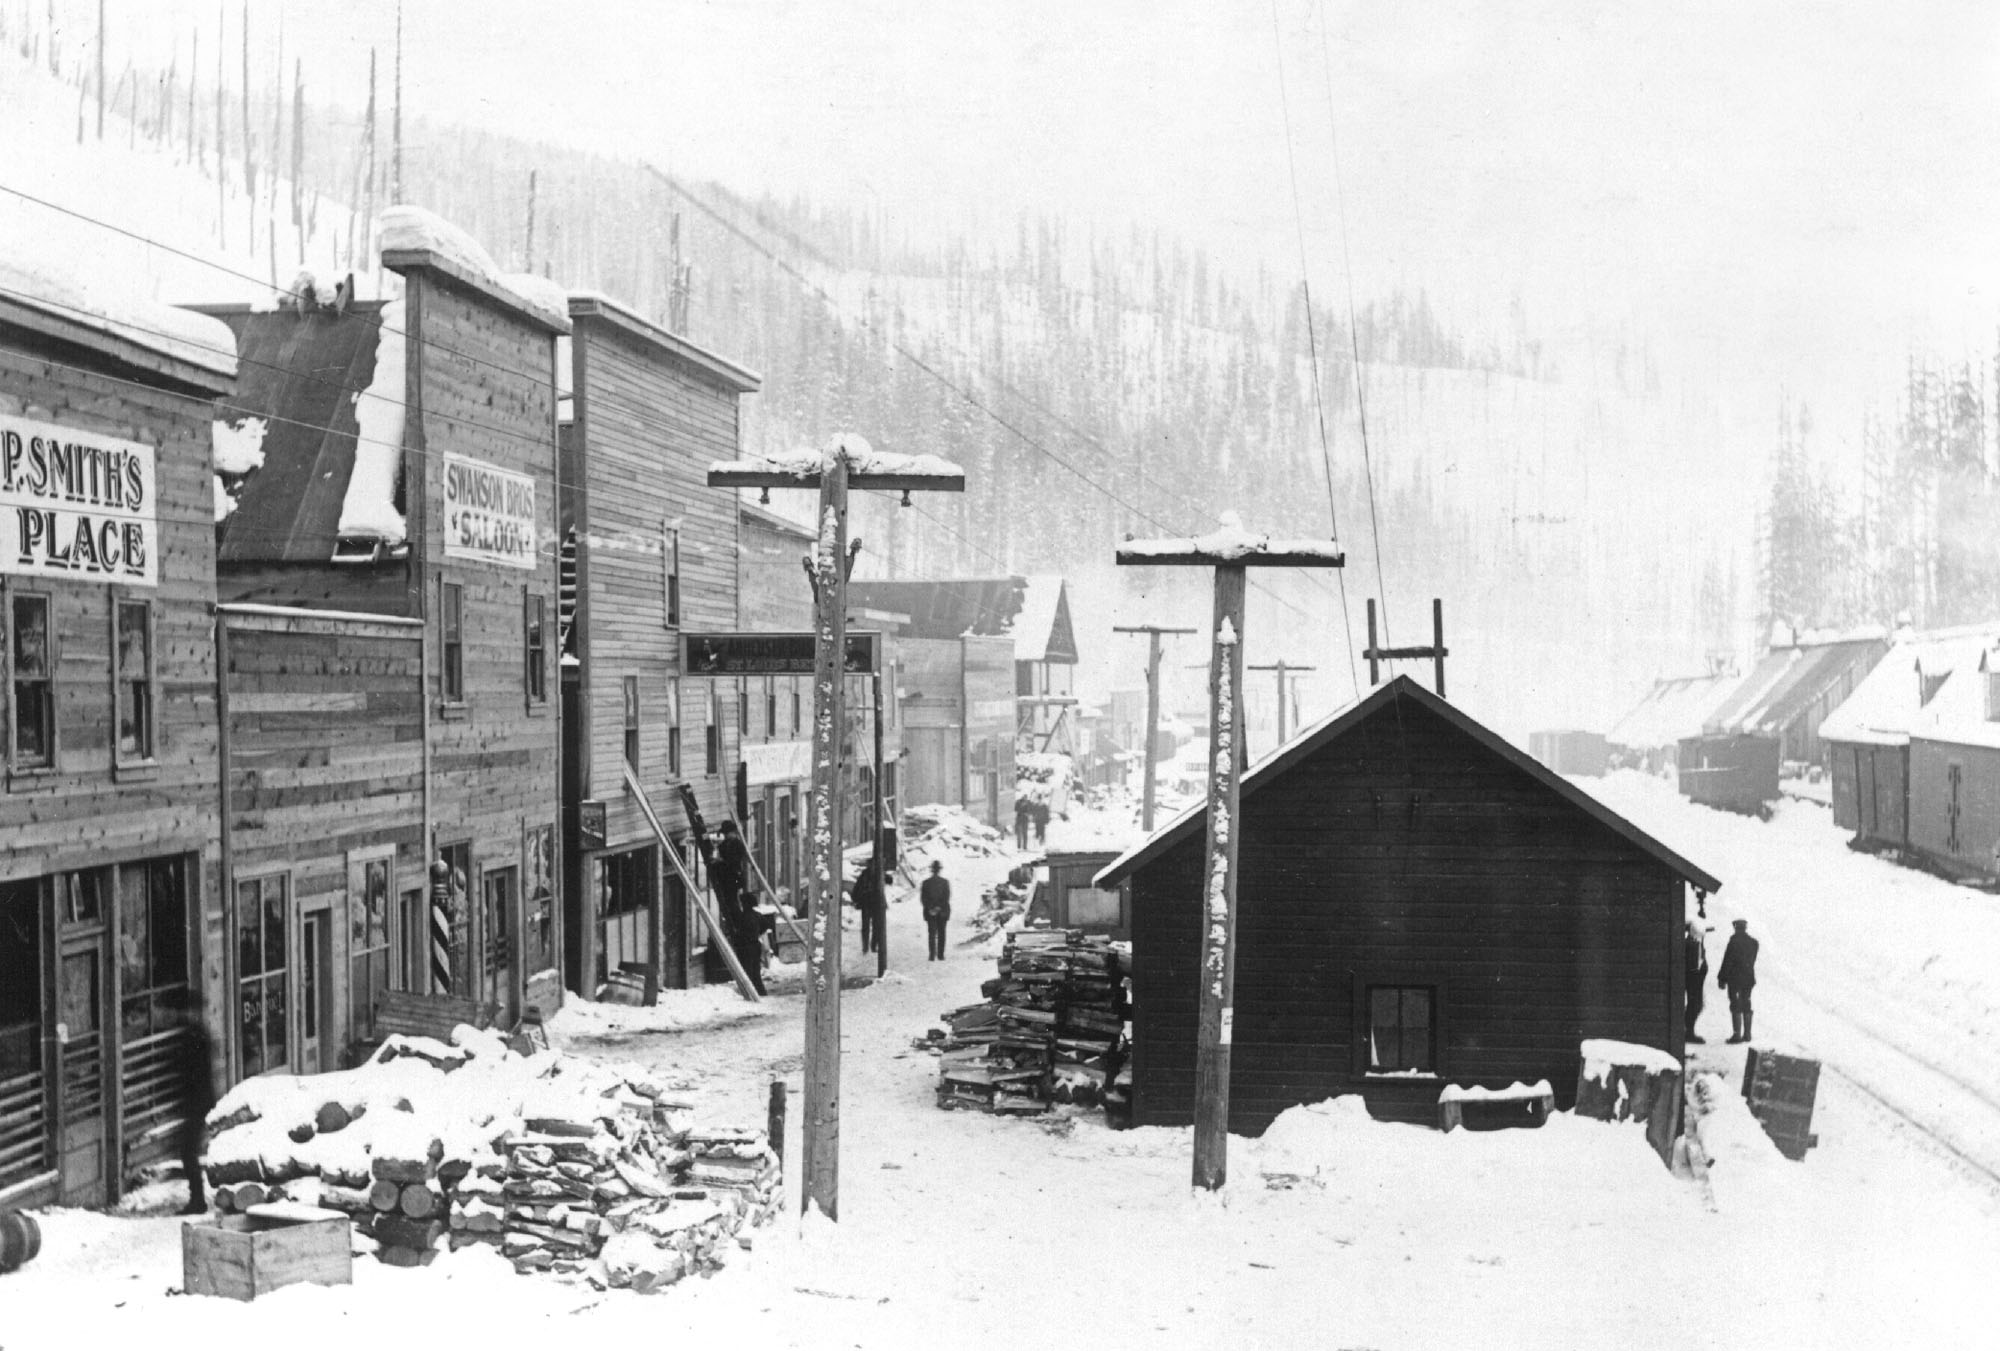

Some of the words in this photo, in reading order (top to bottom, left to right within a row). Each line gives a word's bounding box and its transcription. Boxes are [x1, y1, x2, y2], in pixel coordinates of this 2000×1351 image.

[447, 463, 504, 513] SWANSON
[506, 479, 534, 519] BROS
[17, 507, 146, 577] PLACE
